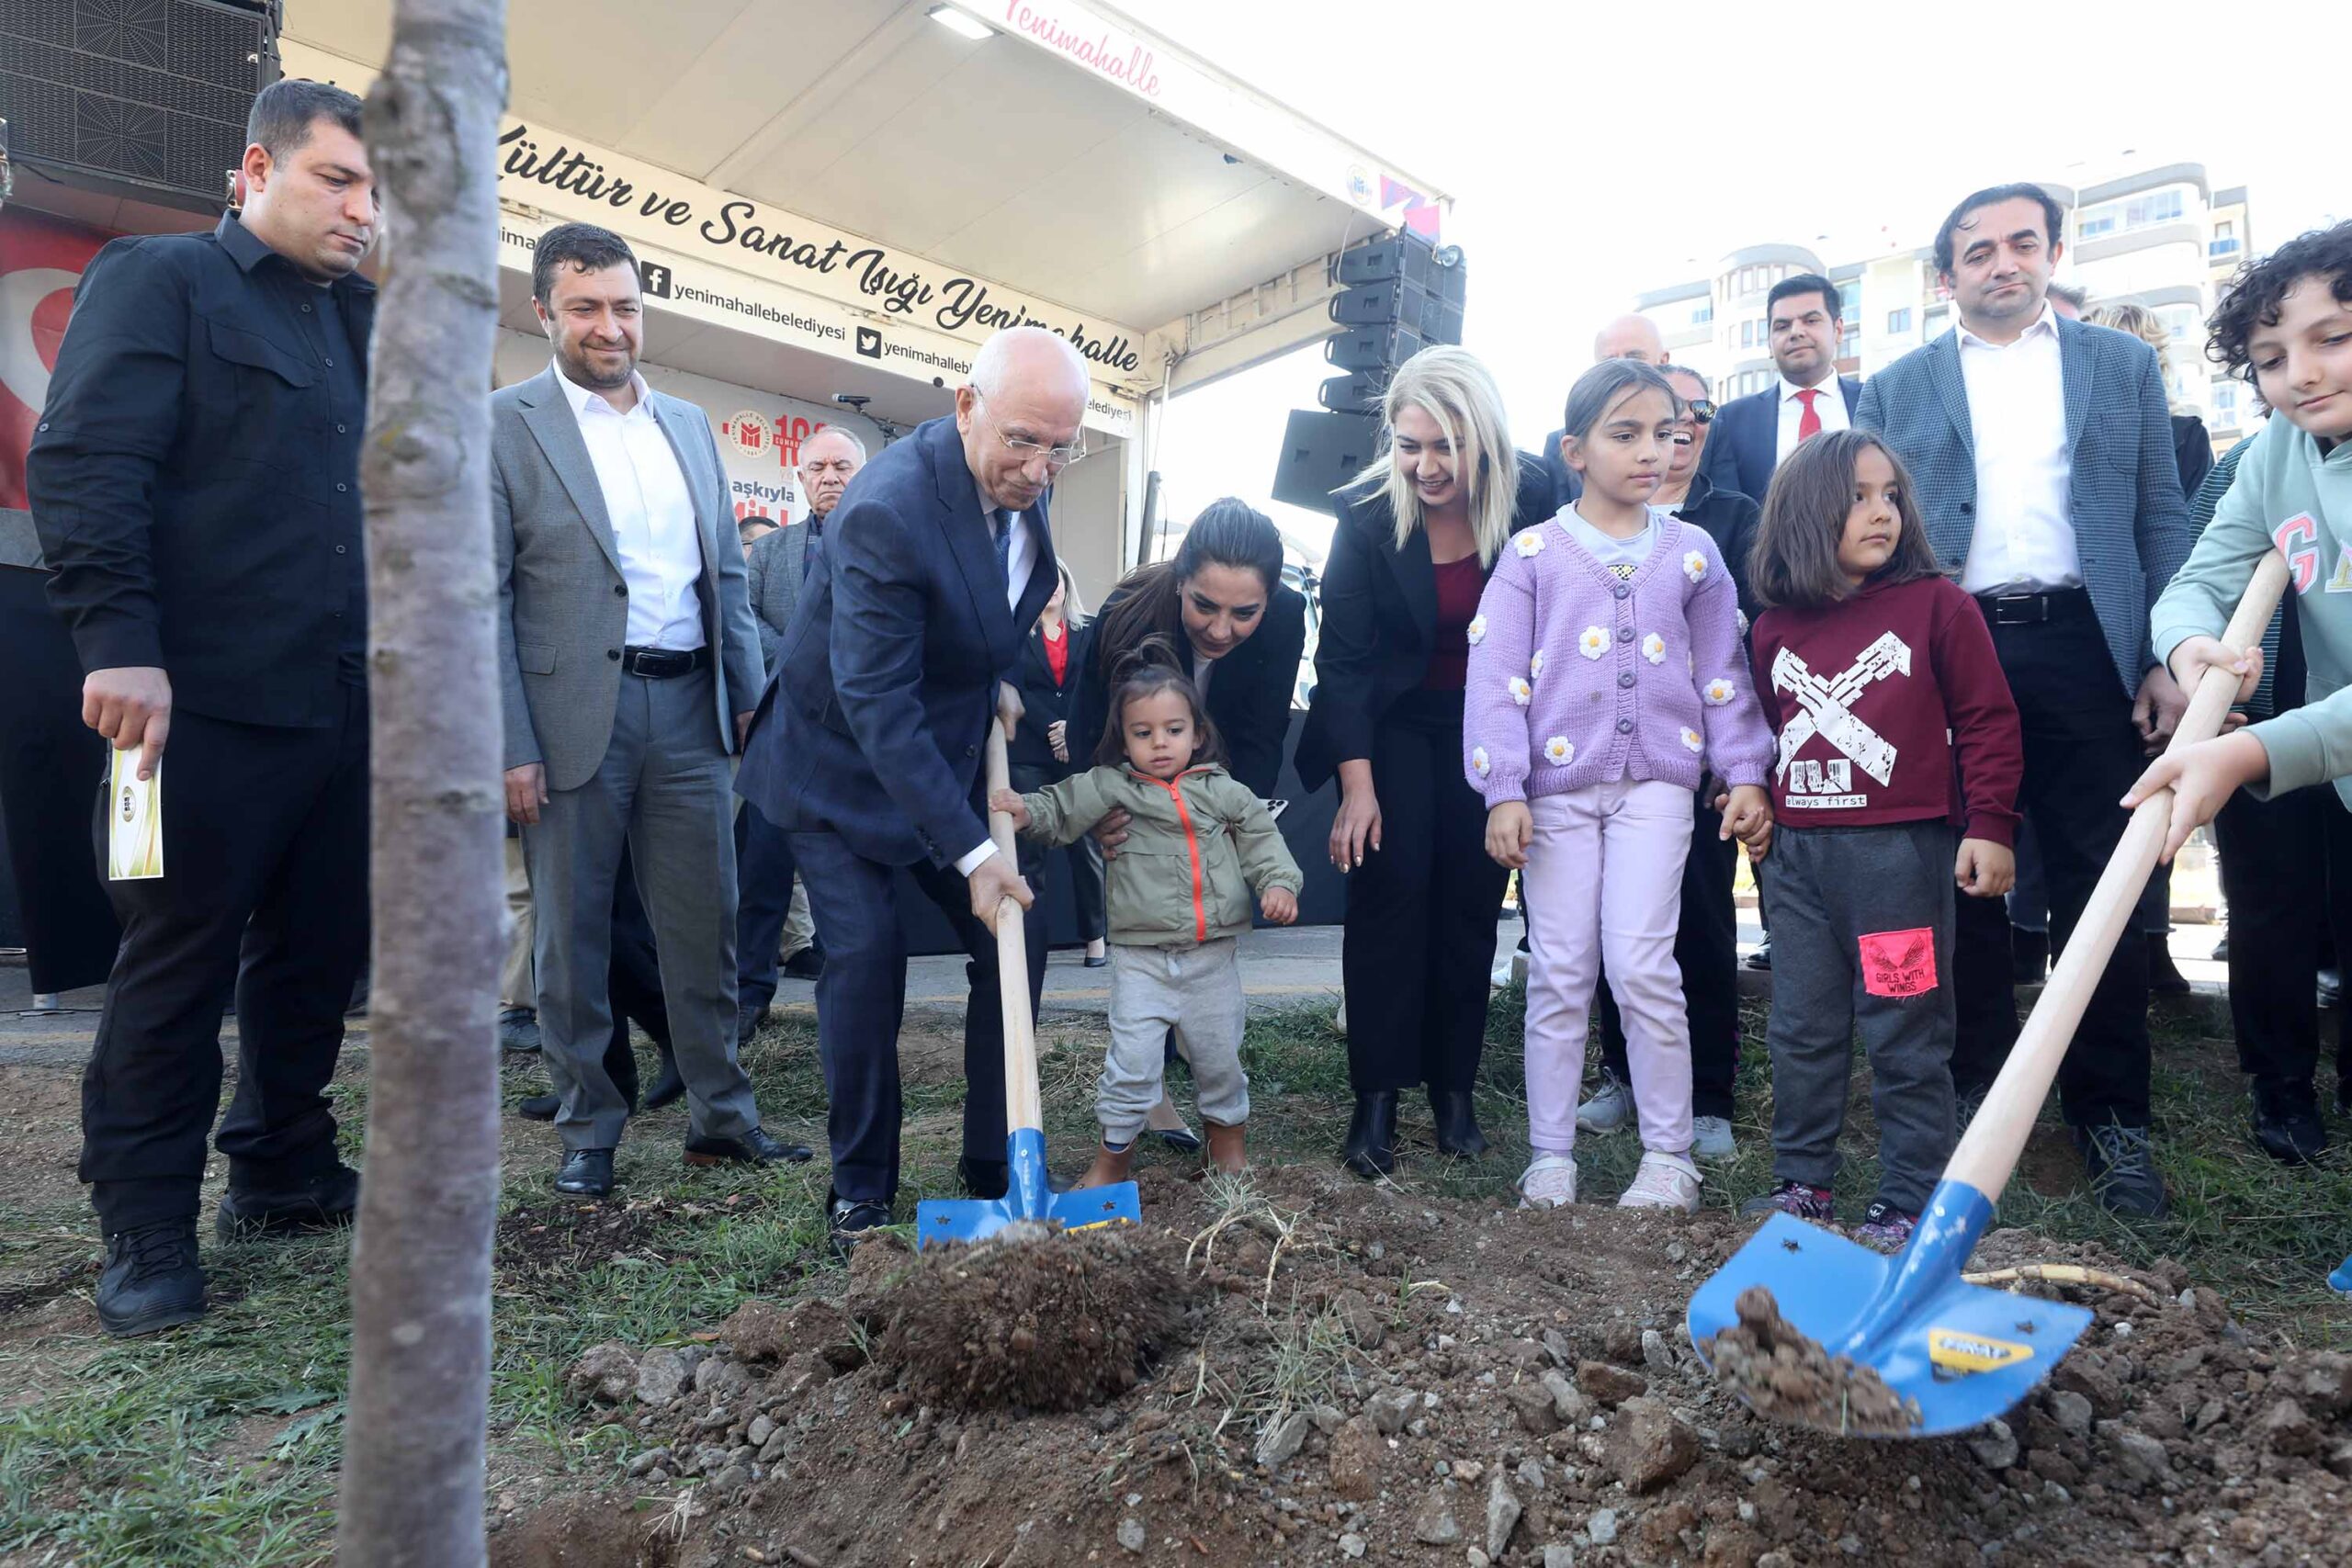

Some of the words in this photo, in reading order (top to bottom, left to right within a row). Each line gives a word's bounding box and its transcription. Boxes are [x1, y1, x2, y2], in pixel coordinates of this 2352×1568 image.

[640, 191, 692, 226] ve
[700, 201, 848, 274] Sanat
[845, 249, 933, 314] Işığı
[674, 284, 845, 341] yenimahallebelediyesi
[1086, 398, 1132, 422] elediyesi
[732, 480, 795, 503] aşkıyla
[1787, 796, 1819, 808] always
[1826, 795, 1866, 807] first
[1876, 973, 1900, 983] GIRLS
[1902, 968, 1926, 982] WITH
[1887, 981, 1917, 993] WINGS
